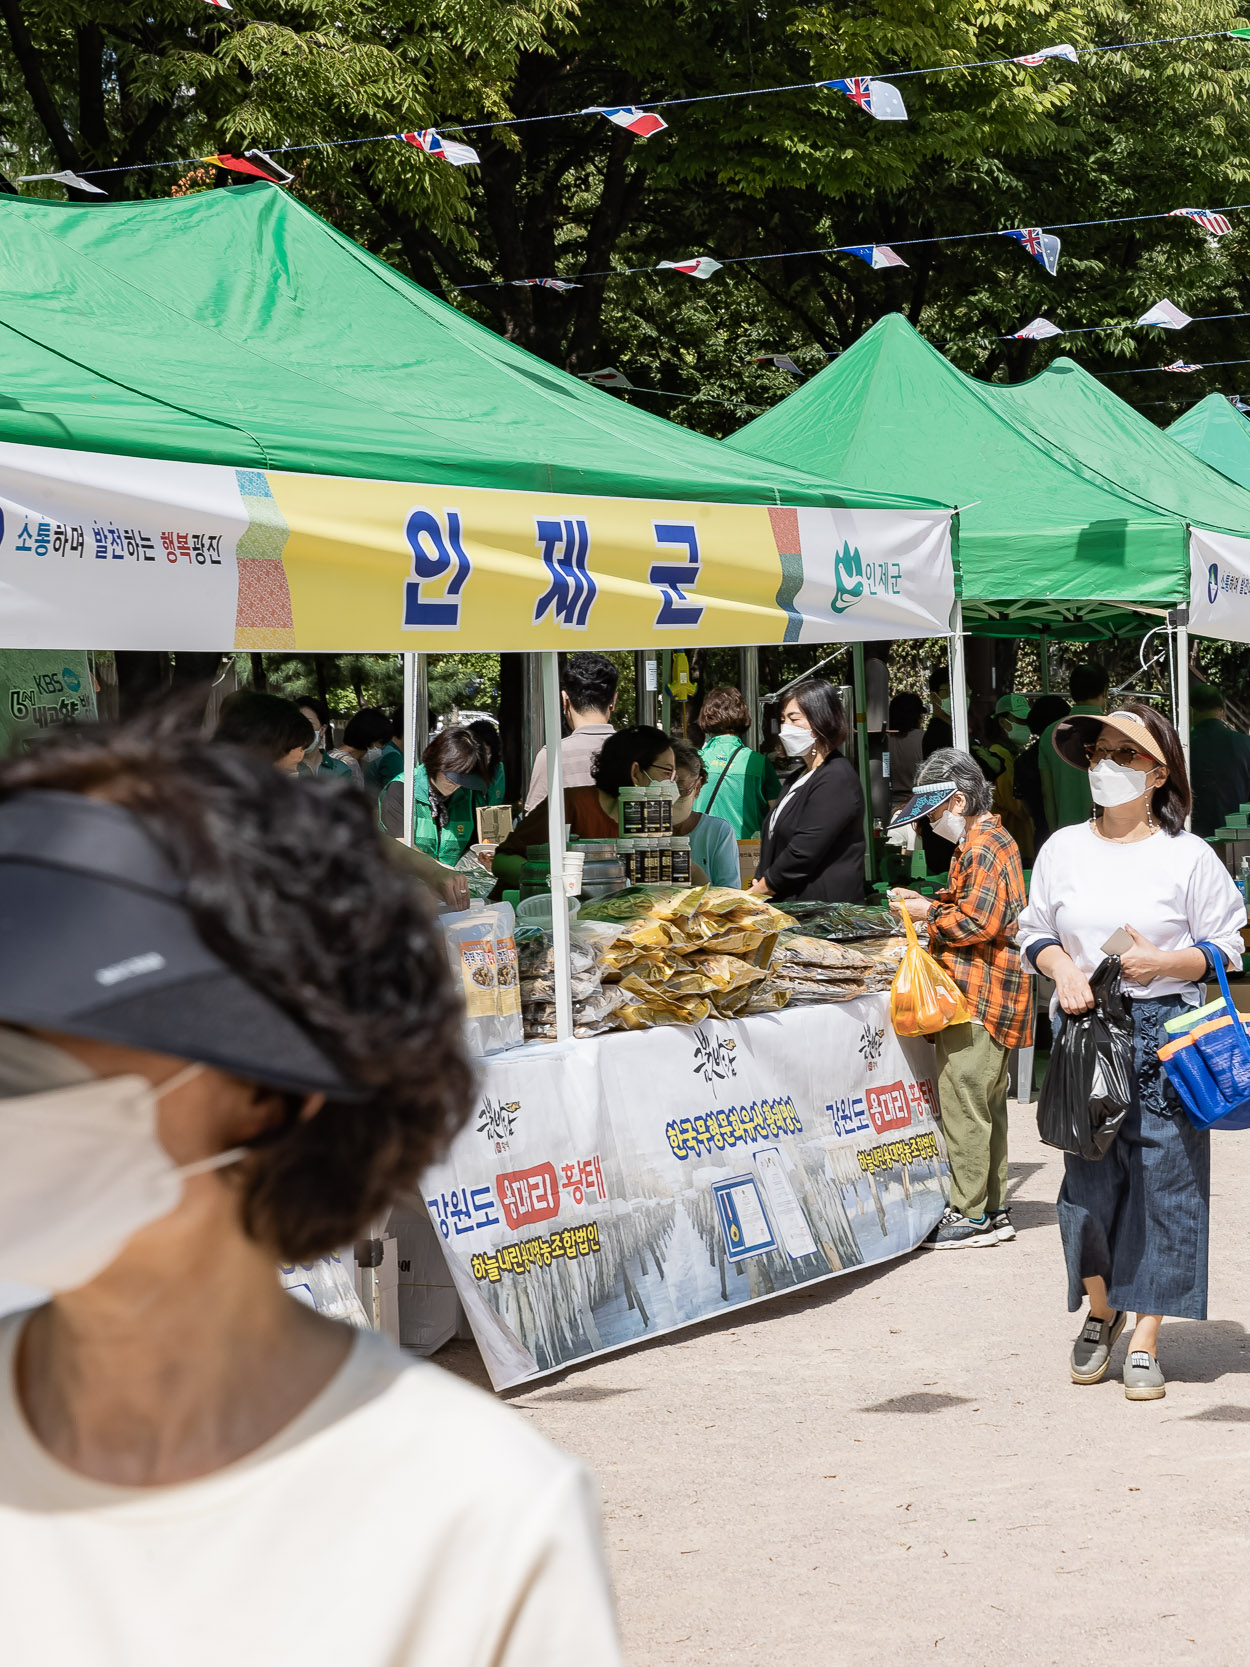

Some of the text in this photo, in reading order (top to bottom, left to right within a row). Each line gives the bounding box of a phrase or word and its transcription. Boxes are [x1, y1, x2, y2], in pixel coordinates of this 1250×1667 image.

[15, 514, 223, 565] 소통하며 발전하는 행복광진
[865, 562, 902, 595] 인제군
[33, 673, 64, 695] KBS
[666, 1101, 769, 1160] 한국무형문화유산
[826, 1078, 940, 1137] 강원도 용대리 황태
[428, 1155, 607, 1239] 강원도 용대리 황태
[471, 1221, 600, 1285] 하늘내린용대영농조합법인
